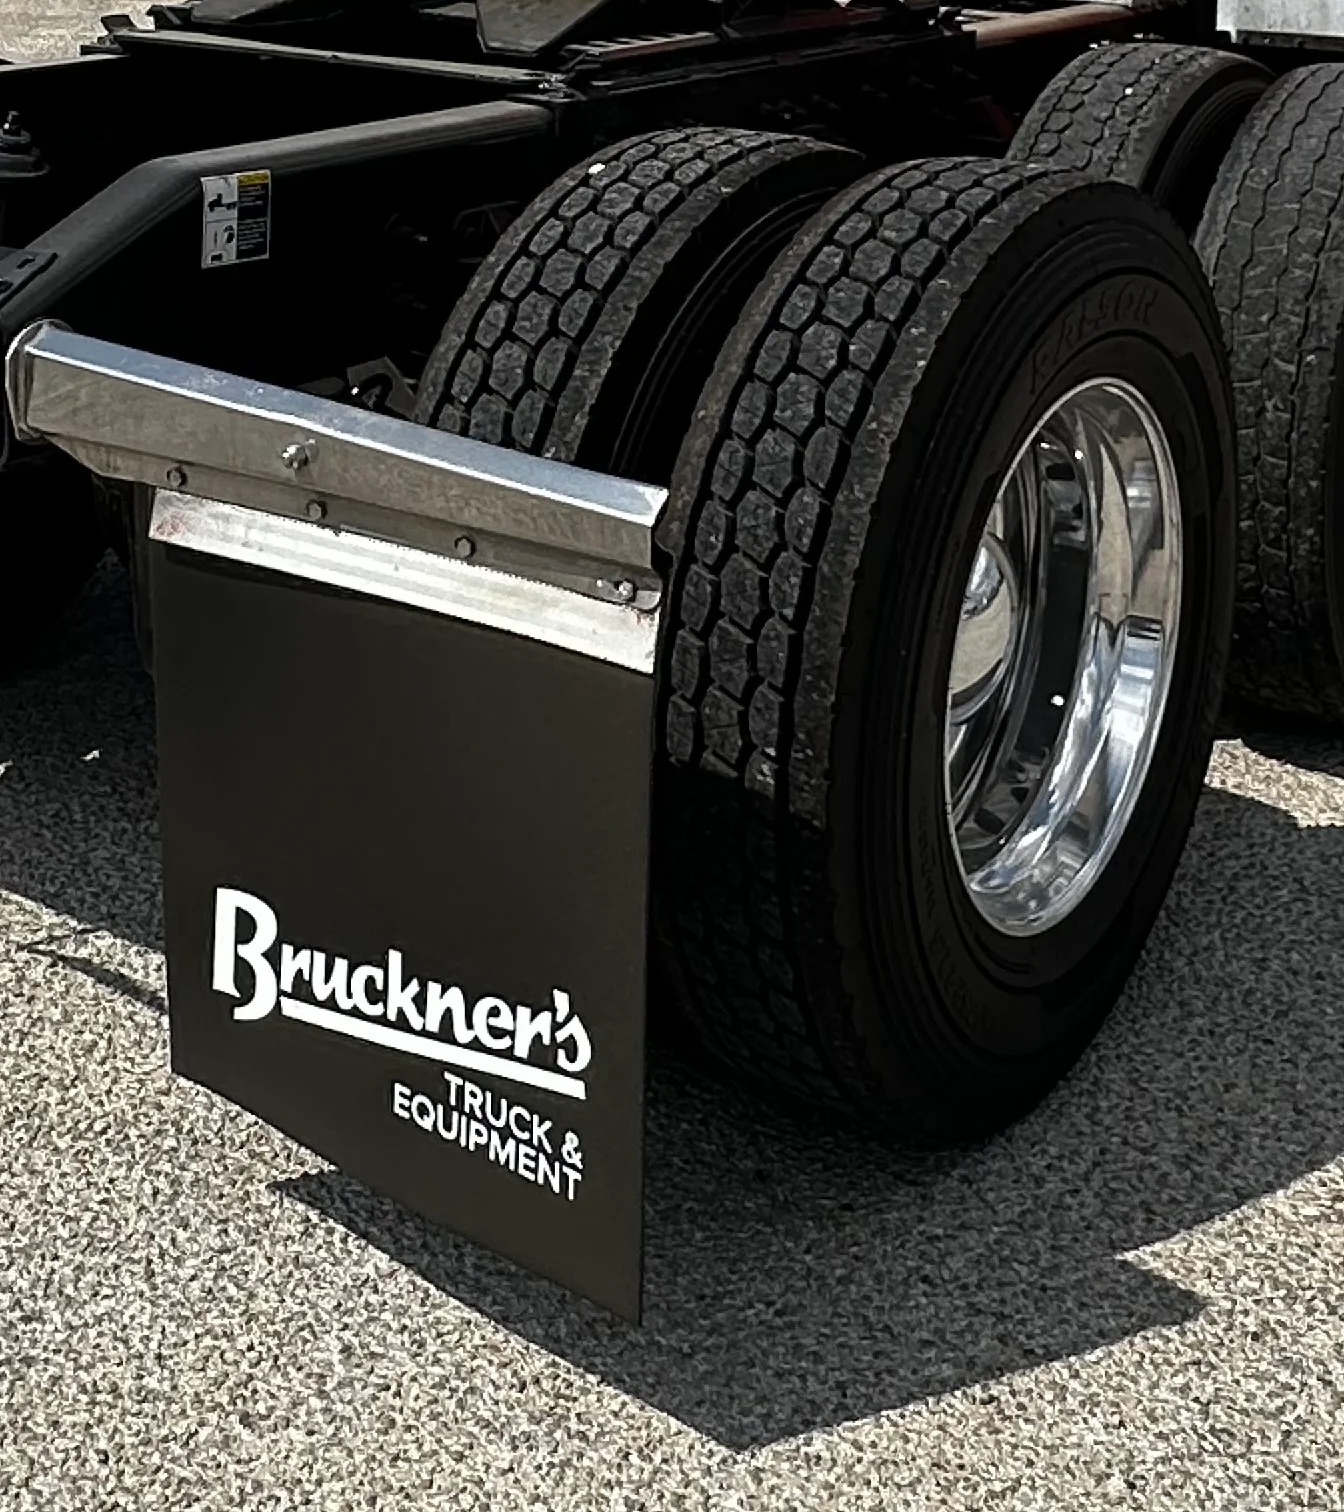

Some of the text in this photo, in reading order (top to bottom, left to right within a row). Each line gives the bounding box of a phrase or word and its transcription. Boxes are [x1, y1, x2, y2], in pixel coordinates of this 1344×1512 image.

[212, 887, 592, 1072] Bruckner's
[392, 1082, 582, 1201] EQUIPMENT
[444, 1071, 585, 1170] TRUCK &
